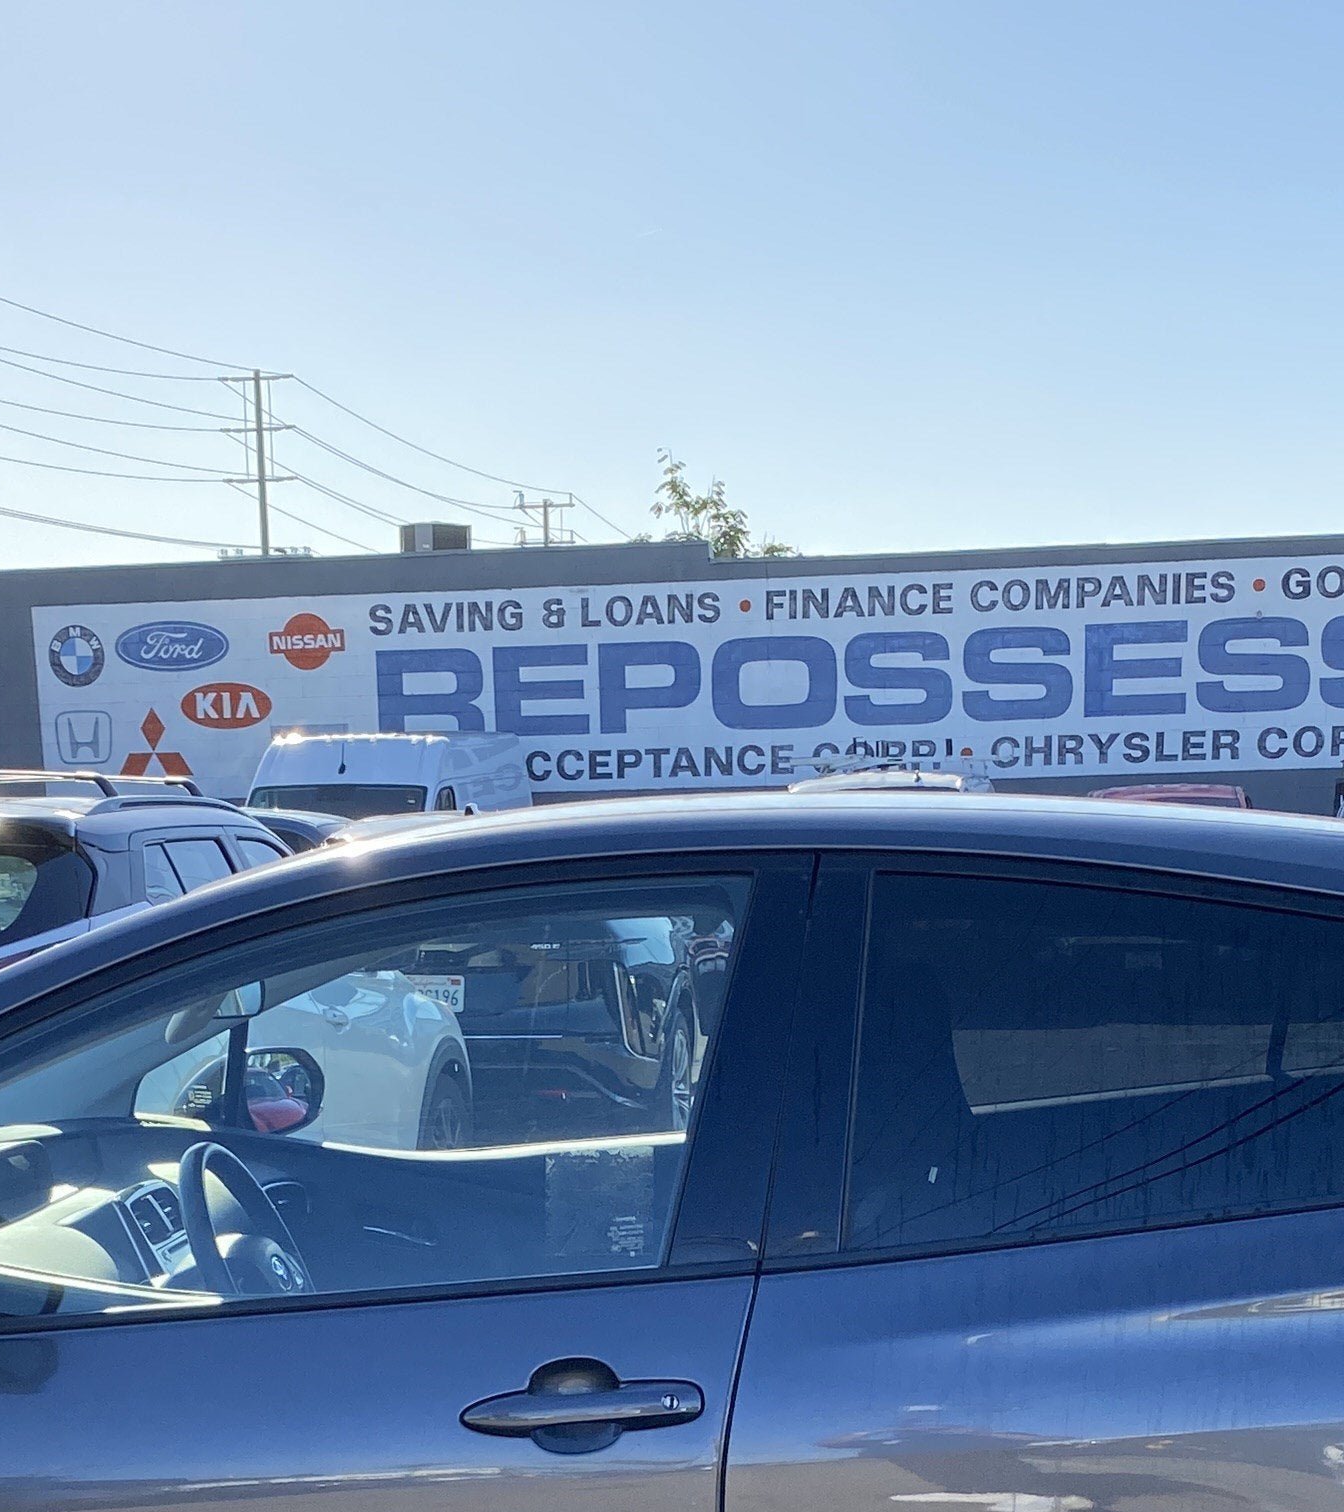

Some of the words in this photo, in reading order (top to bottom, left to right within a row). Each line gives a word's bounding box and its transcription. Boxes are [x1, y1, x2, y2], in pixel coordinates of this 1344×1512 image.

[369, 600, 524, 636] SAVING
[543, 598, 566, 629] &
[581, 591, 721, 628] LOANS
[766, 582, 954, 620] FINANCE
[970, 571, 1236, 612] COMPANIES
[50, 626, 102, 653] BMW
[140, 630, 204, 660] Ford
[272, 632, 342, 650] NISSAN
[193, 691, 261, 719] KIA
[526, 744, 795, 781] CCEPTANCE
[991, 730, 1241, 768] CHRYSLER
